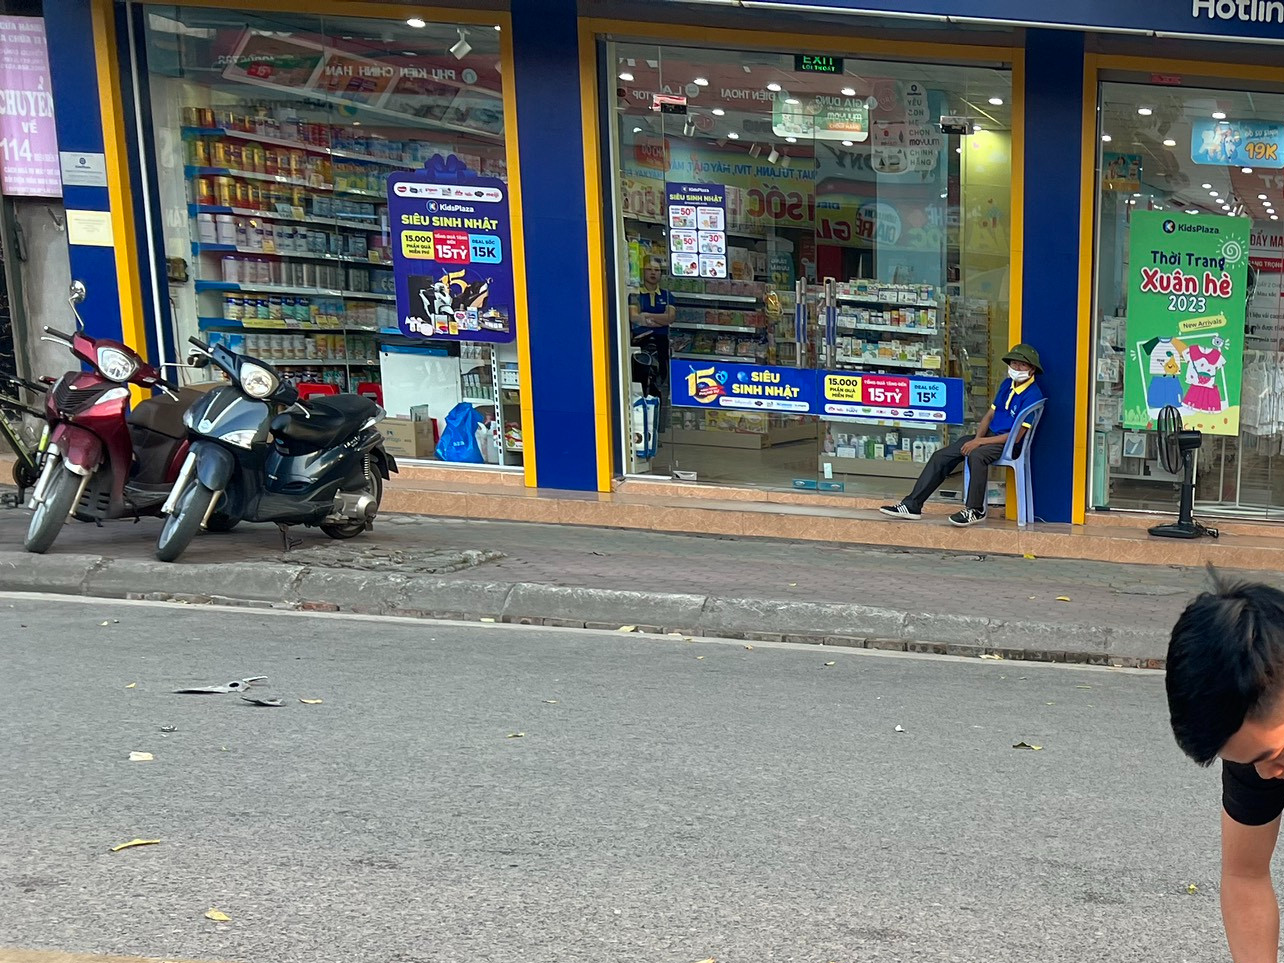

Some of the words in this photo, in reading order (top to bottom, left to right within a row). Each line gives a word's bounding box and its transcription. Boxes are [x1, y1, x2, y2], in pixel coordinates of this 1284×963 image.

[1244, 142, 1279, 160] 19K
[440, 203, 474, 213] KidsPlaza
[401, 213, 430, 226] SIÊU
[432, 216, 462, 228] SINH
[464, 217, 498, 232] NHẬT
[1178, 223, 1220, 234] KidsPlaza
[405, 235, 432, 243] 15.000
[472, 246, 496, 258] 15K
[1151, 250, 1182, 266] Thời
[1186, 253, 1226, 271] Trang
[1140, 267, 1199, 295] Xuân
[1203, 271, 1233, 297] hè
[1168, 295, 1206, 313] 2023
[1198, 317, 1223, 327] Arrivals
[751, 370, 780, 383] SIÊU
[828, 378, 858, 387] 15.000
[732, 383, 762, 396] SINH
[765, 384, 800, 400] NHẬT
[916, 391, 937, 403] 15K
